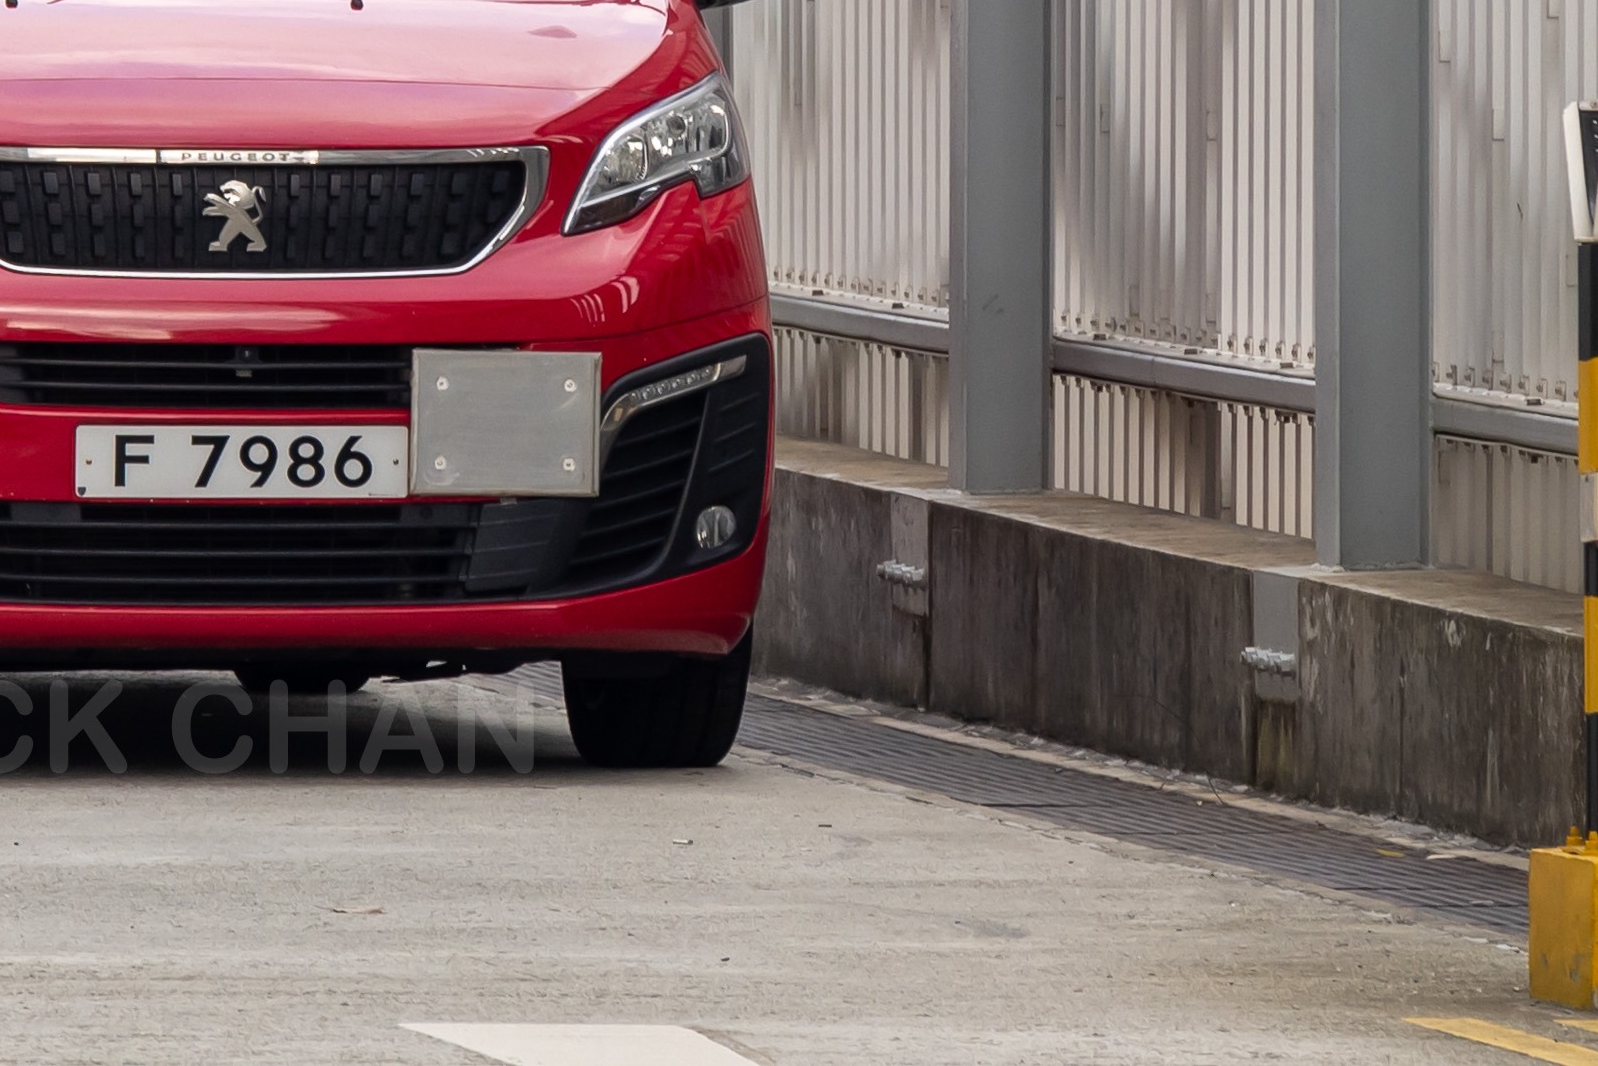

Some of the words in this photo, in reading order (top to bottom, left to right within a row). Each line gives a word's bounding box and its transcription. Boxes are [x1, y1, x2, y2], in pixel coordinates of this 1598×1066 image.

[182, 152, 289, 162] PEUGEOT
[114, 434, 155, 487] F
[191, 435, 373, 488] 7986
